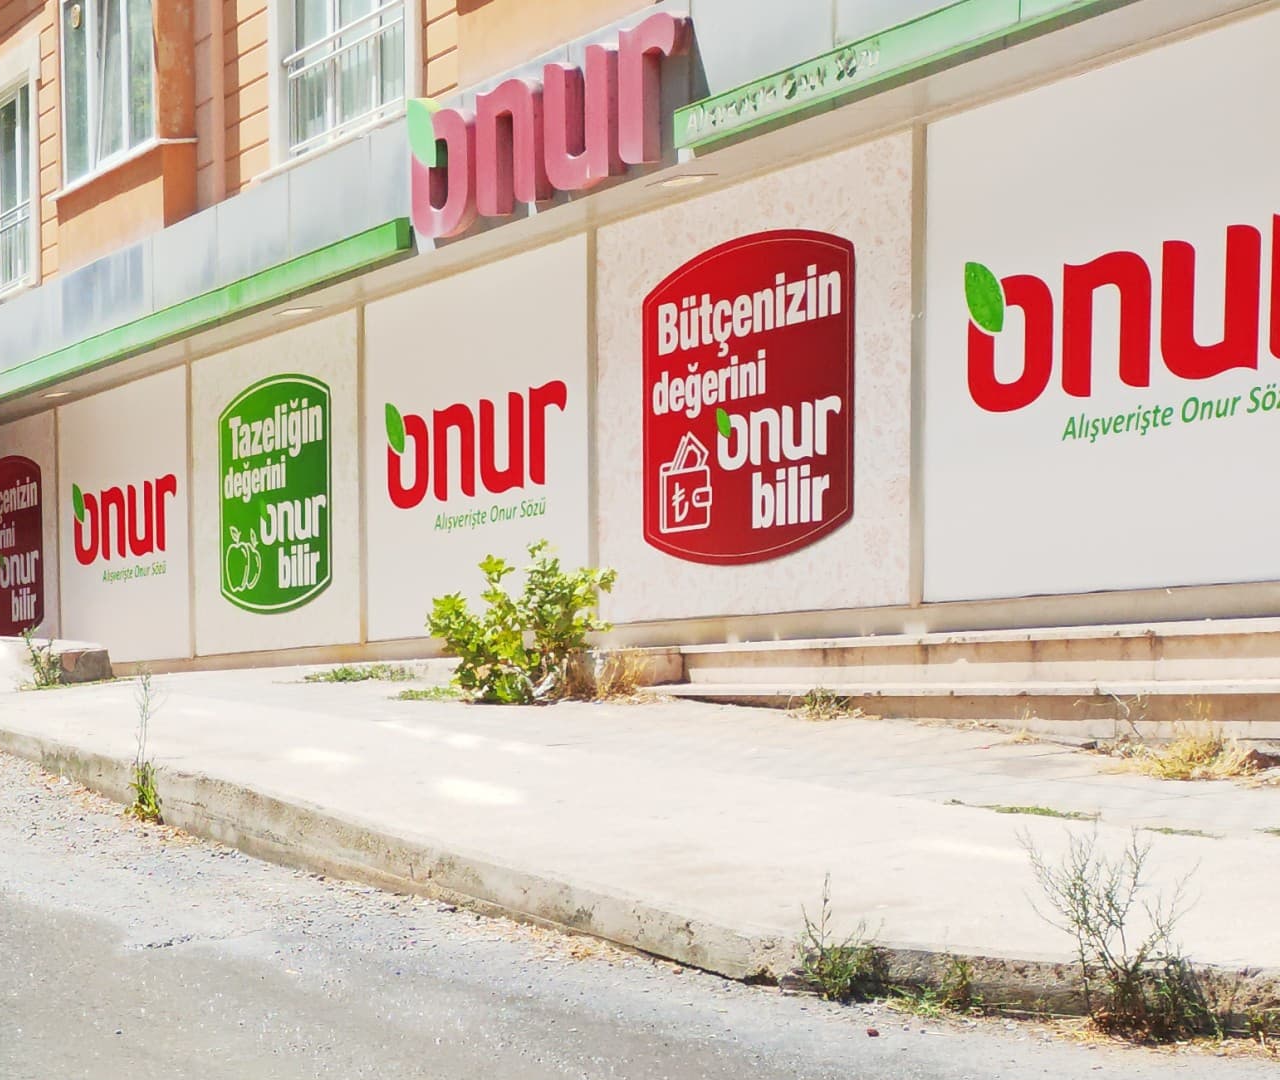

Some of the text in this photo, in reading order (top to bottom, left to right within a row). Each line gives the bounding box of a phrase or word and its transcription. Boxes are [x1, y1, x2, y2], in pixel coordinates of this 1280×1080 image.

[407, 12, 686, 238] onur
[657, 264, 842, 358] Bütçenizin
[964, 213, 1280, 413] onu
[652, 348, 767, 419] değerini
[1061, 383, 1280, 443] Alışverişte Onur Sö
[228, 397, 323, 461] Tazeliğin
[385, 380, 567, 510] onur
[716, 395, 842, 471] onur
[224, 454, 286, 503] değerini
[751, 463, 830, 530] bilir
[72, 473, 177, 566] onur
[259, 493, 326, 546] onur
[433, 498, 546, 533] Alışverişte Onur Sözü
[0, 550, 39, 589] onur
[278, 543, 321, 589] bilir
[11, 586, 37, 623] bilir
